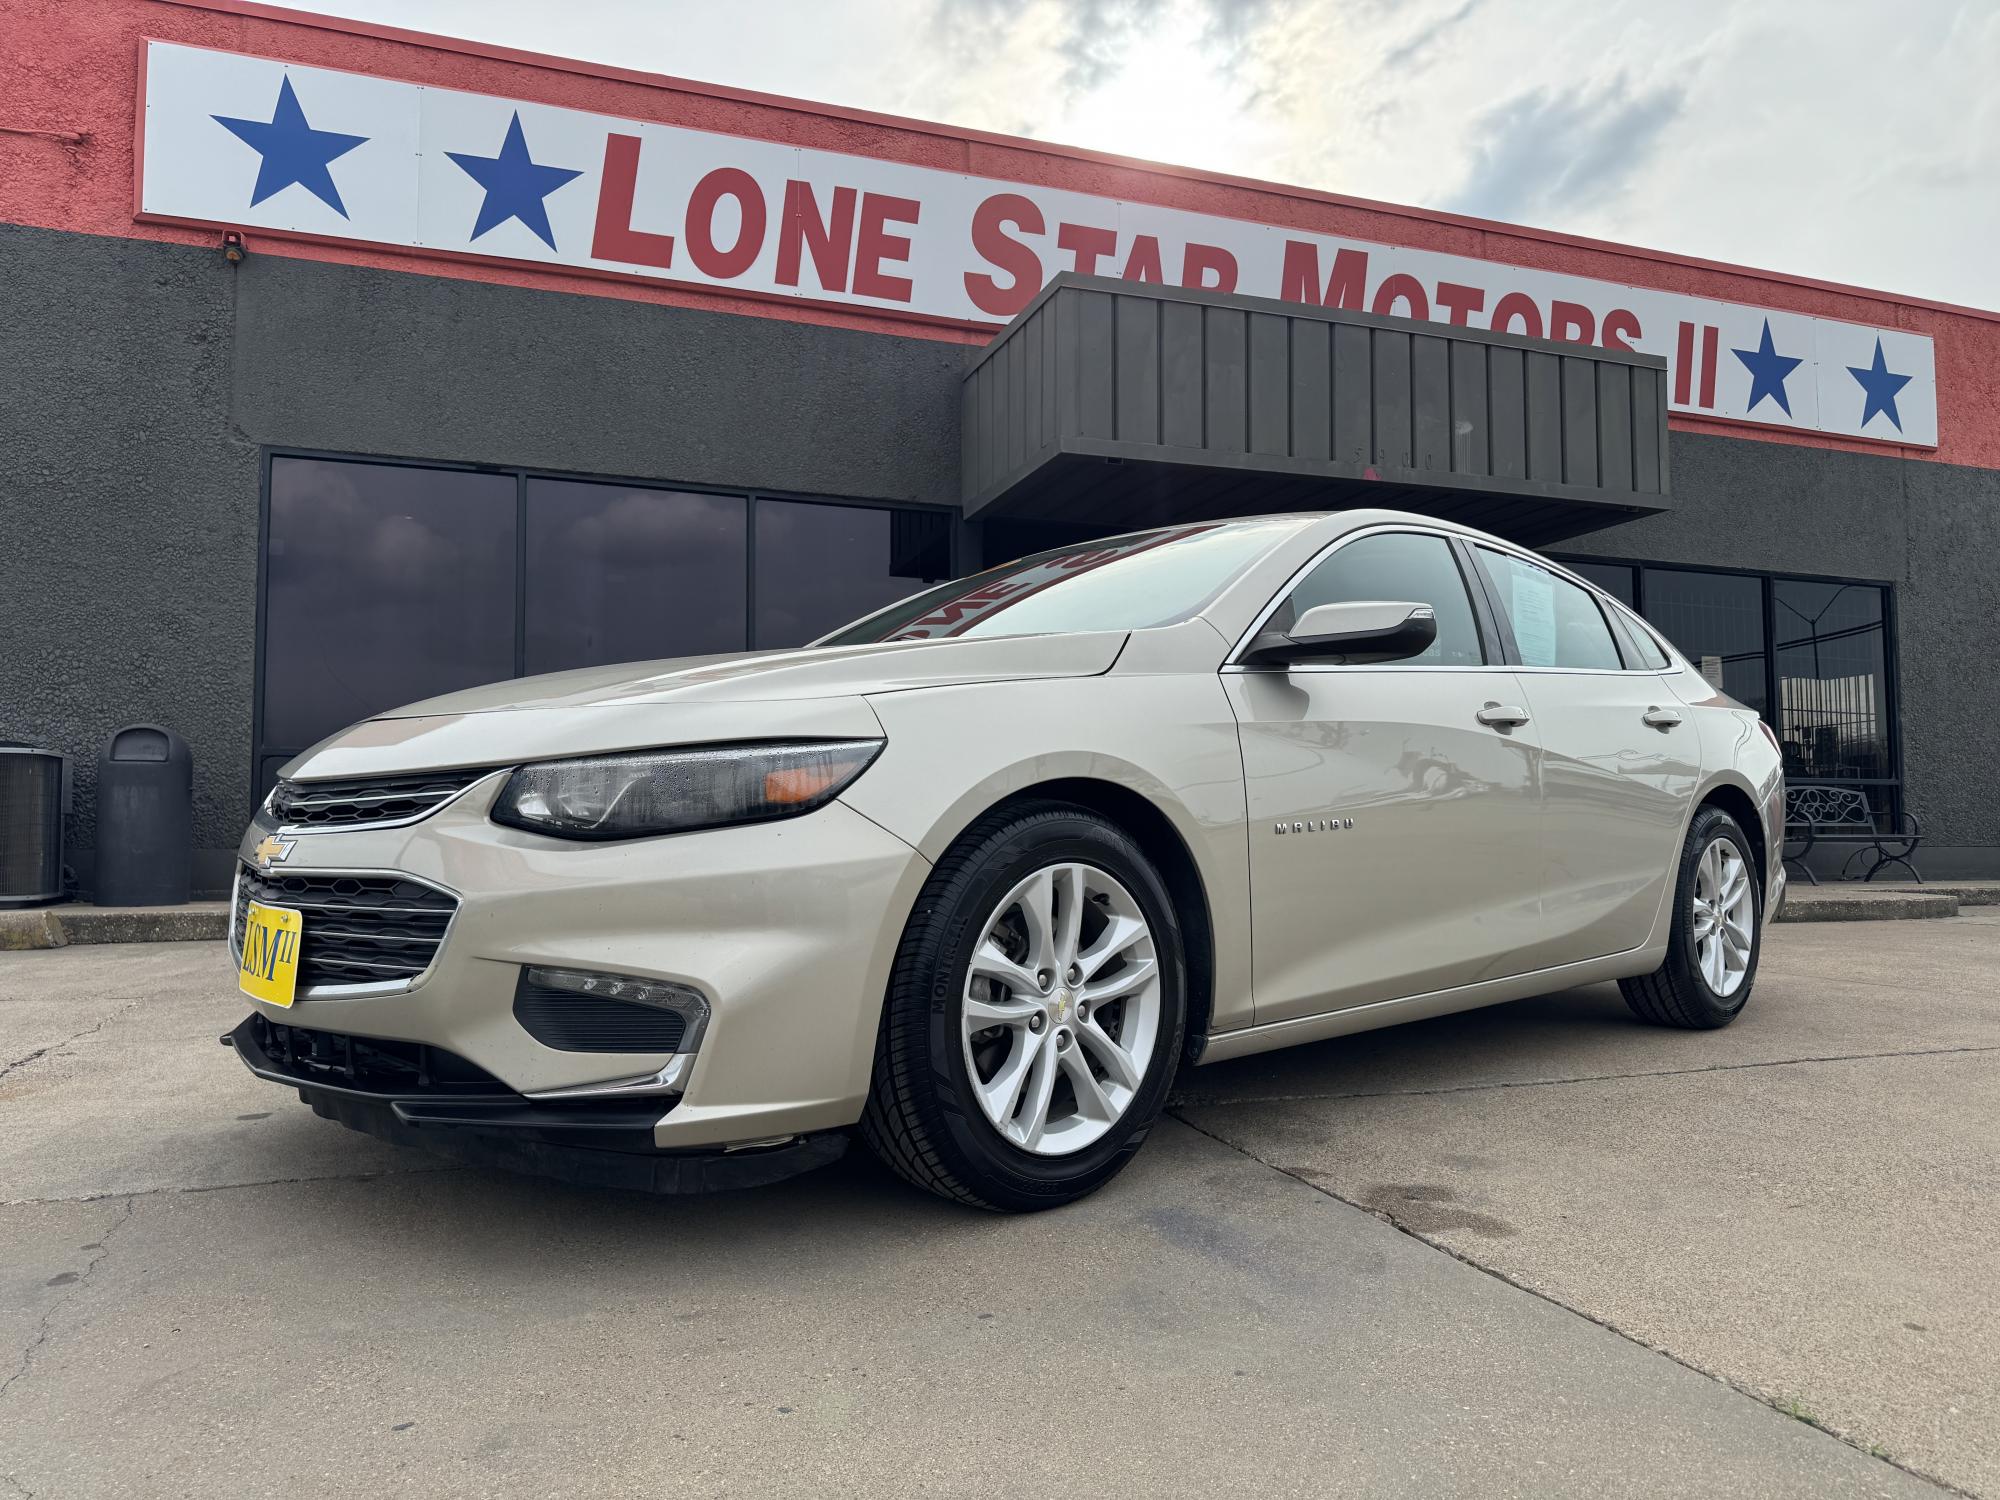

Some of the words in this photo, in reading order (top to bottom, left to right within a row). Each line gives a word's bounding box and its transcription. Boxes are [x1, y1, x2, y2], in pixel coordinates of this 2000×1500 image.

[591, 133, 920, 303] LONE
[1673, 320, 1719, 409] II
[1275, 818, 1354, 834] MALIBU
